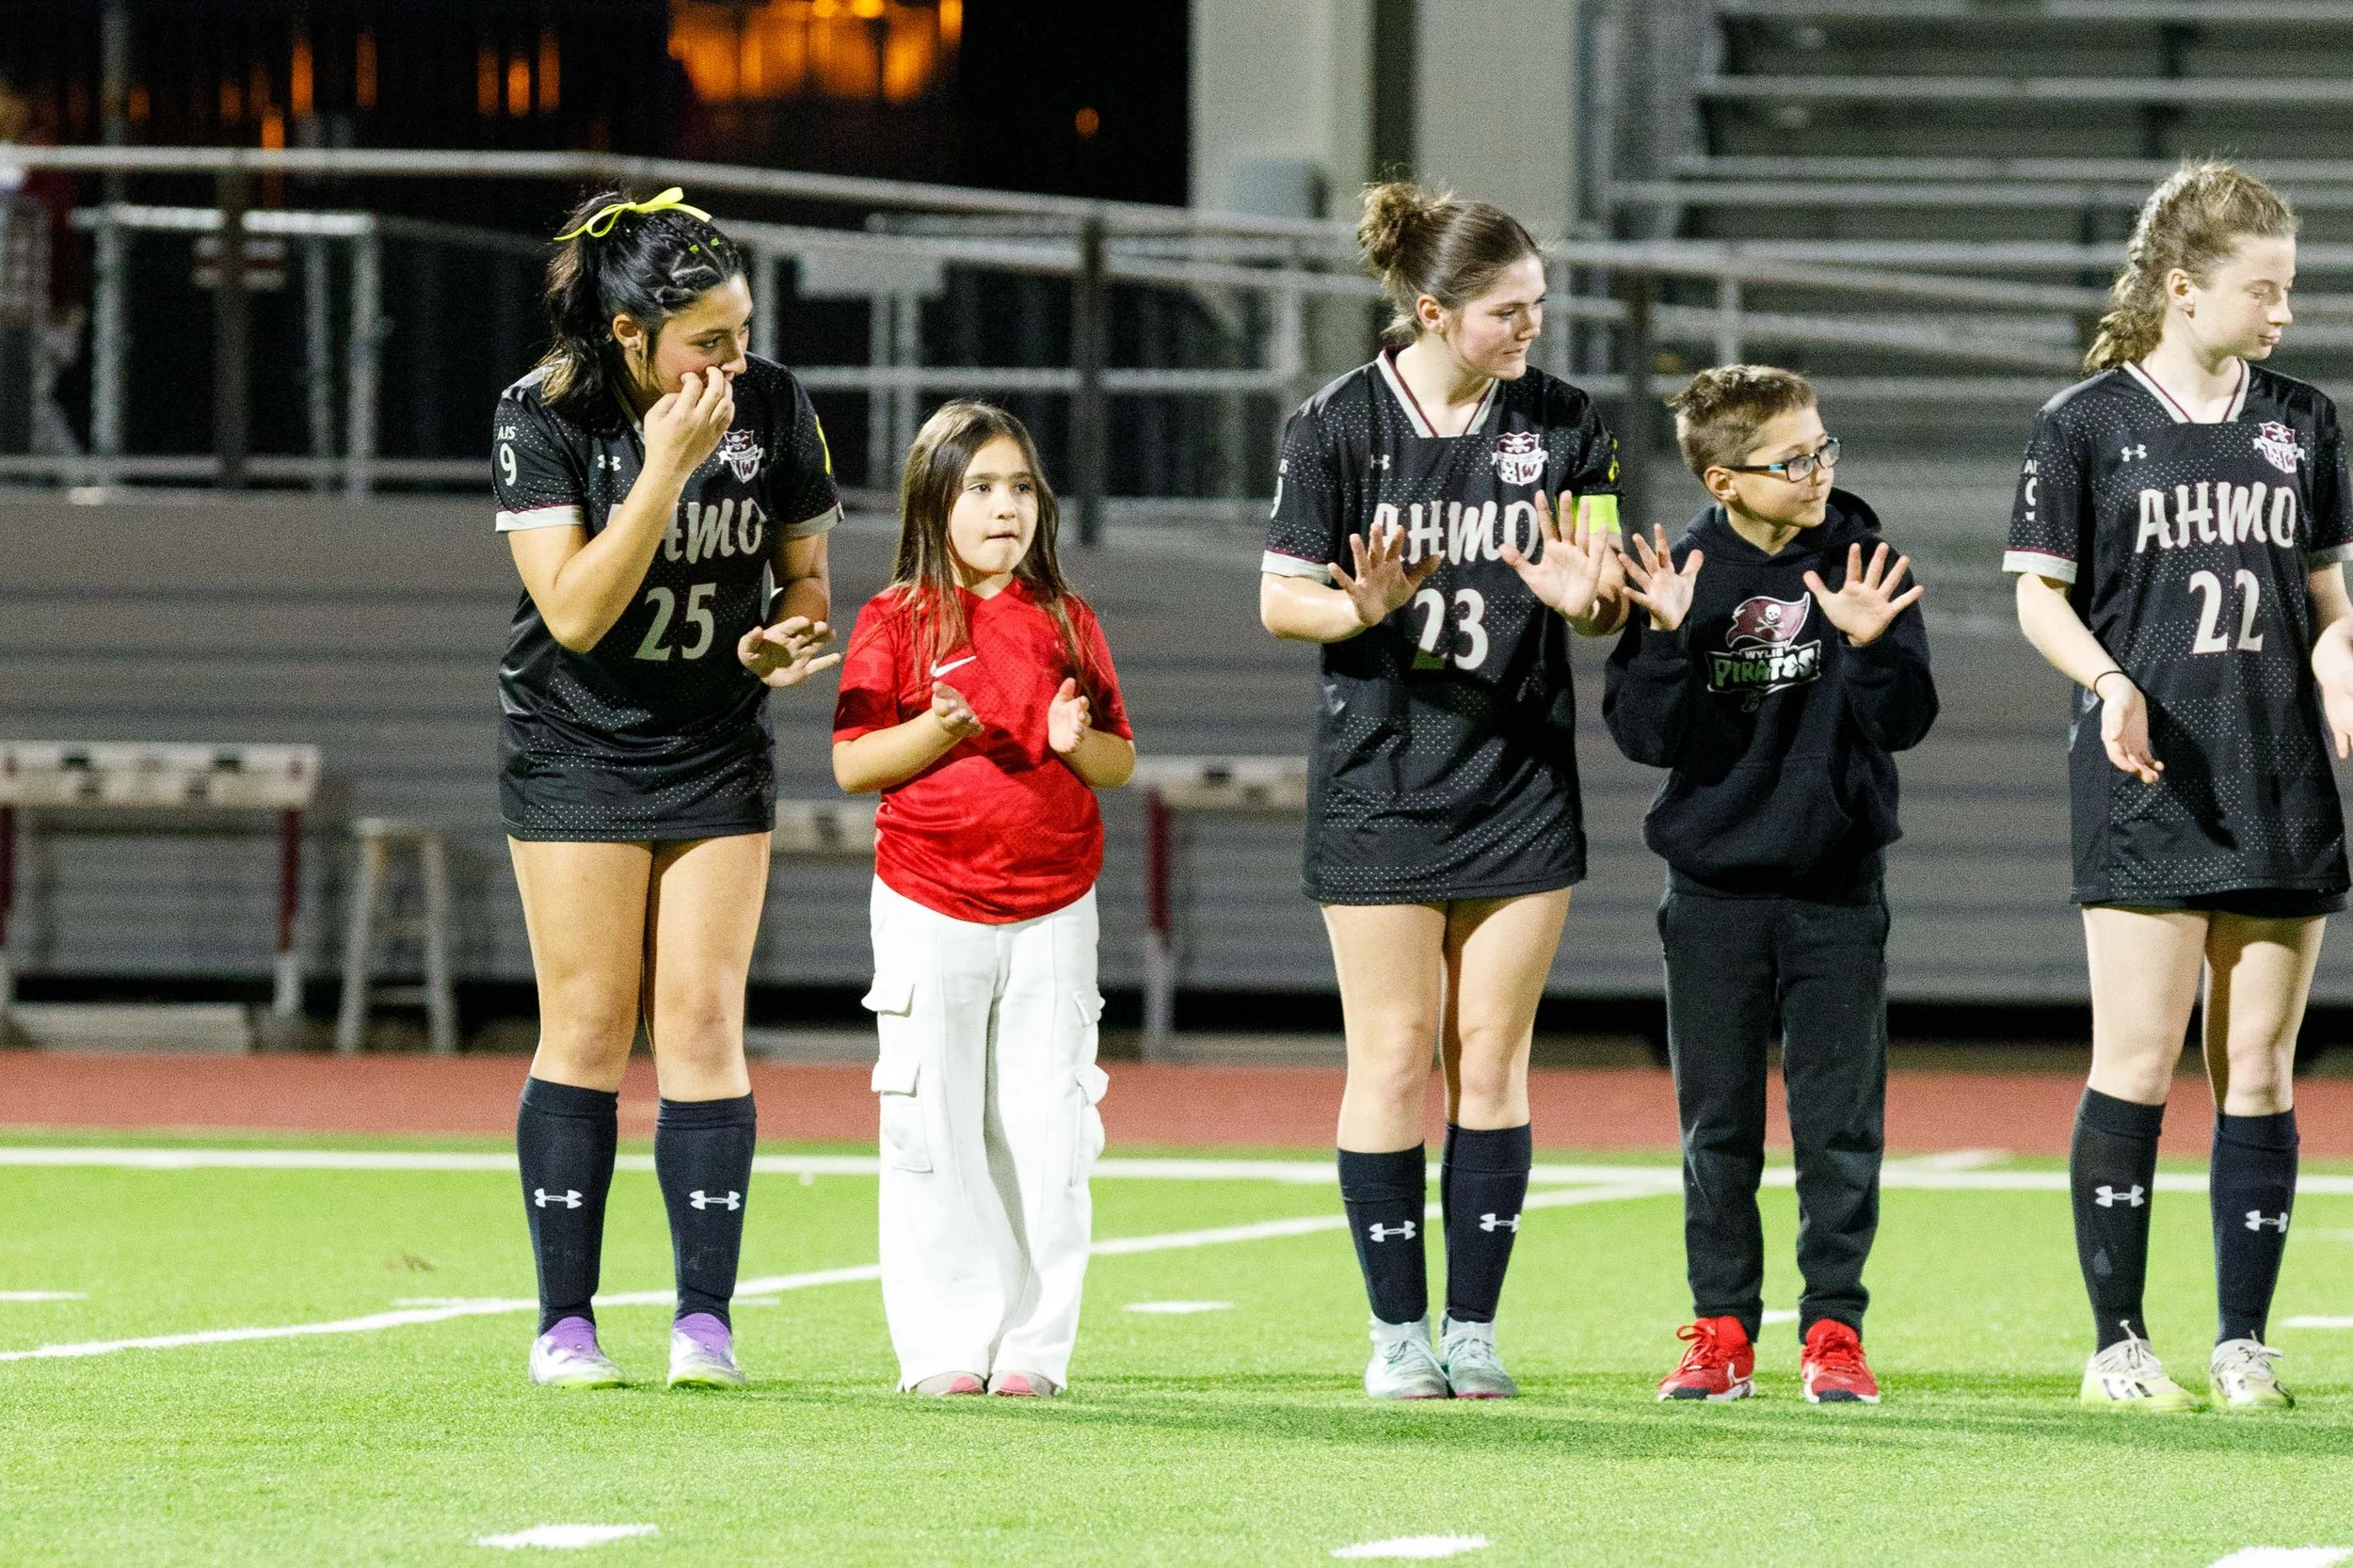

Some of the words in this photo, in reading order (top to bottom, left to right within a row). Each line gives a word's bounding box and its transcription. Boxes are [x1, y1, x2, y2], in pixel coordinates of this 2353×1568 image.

[499, 442, 518, 487] 9
[2135, 480, 2297, 553] AHMO
[633, 582, 717, 662] 25
[1413, 587, 1490, 671] 23
[2188, 568, 2264, 654] 22
[1744, 648, 1785, 659] WYLIE
